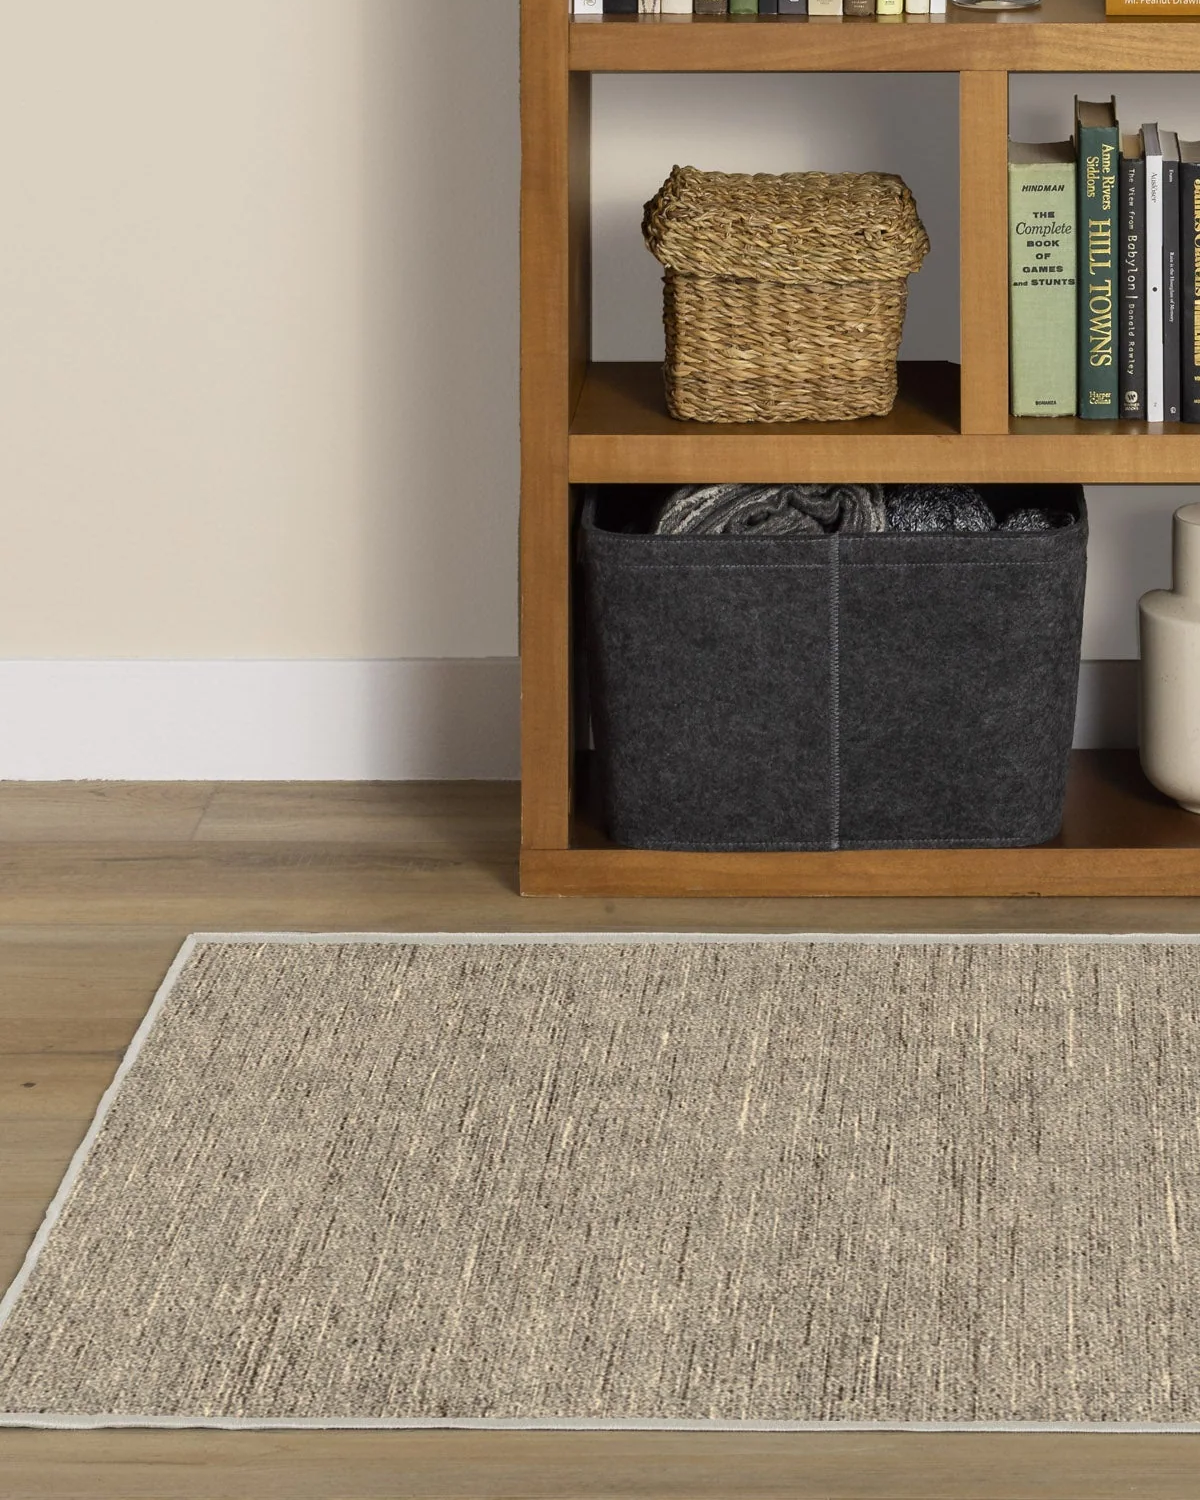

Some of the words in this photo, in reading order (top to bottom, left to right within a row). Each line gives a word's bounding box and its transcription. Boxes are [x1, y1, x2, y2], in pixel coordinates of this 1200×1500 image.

[1101, 143, 1114, 174] Anne
[1021, 184, 1065, 193] HINDMAN
[1086, 156, 1100, 198] Siddons
[1101, 175, 1115, 211] Rivers
[1128, 187, 1136, 207] View
[1032, 211, 1056, 219] THE
[1015, 221, 1072, 238] Complete
[1026, 239, 1060, 248] BOOK
[1088, 218, 1111, 276] HILL
[1022, 266, 1064, 274] GAMES
[1125, 235, 1138, 291] Babylon
[1031, 278, 1076, 286] STUNTS
[1089, 279, 1112, 367] TOWNS
[1126, 341, 1136, 375] Rawley
